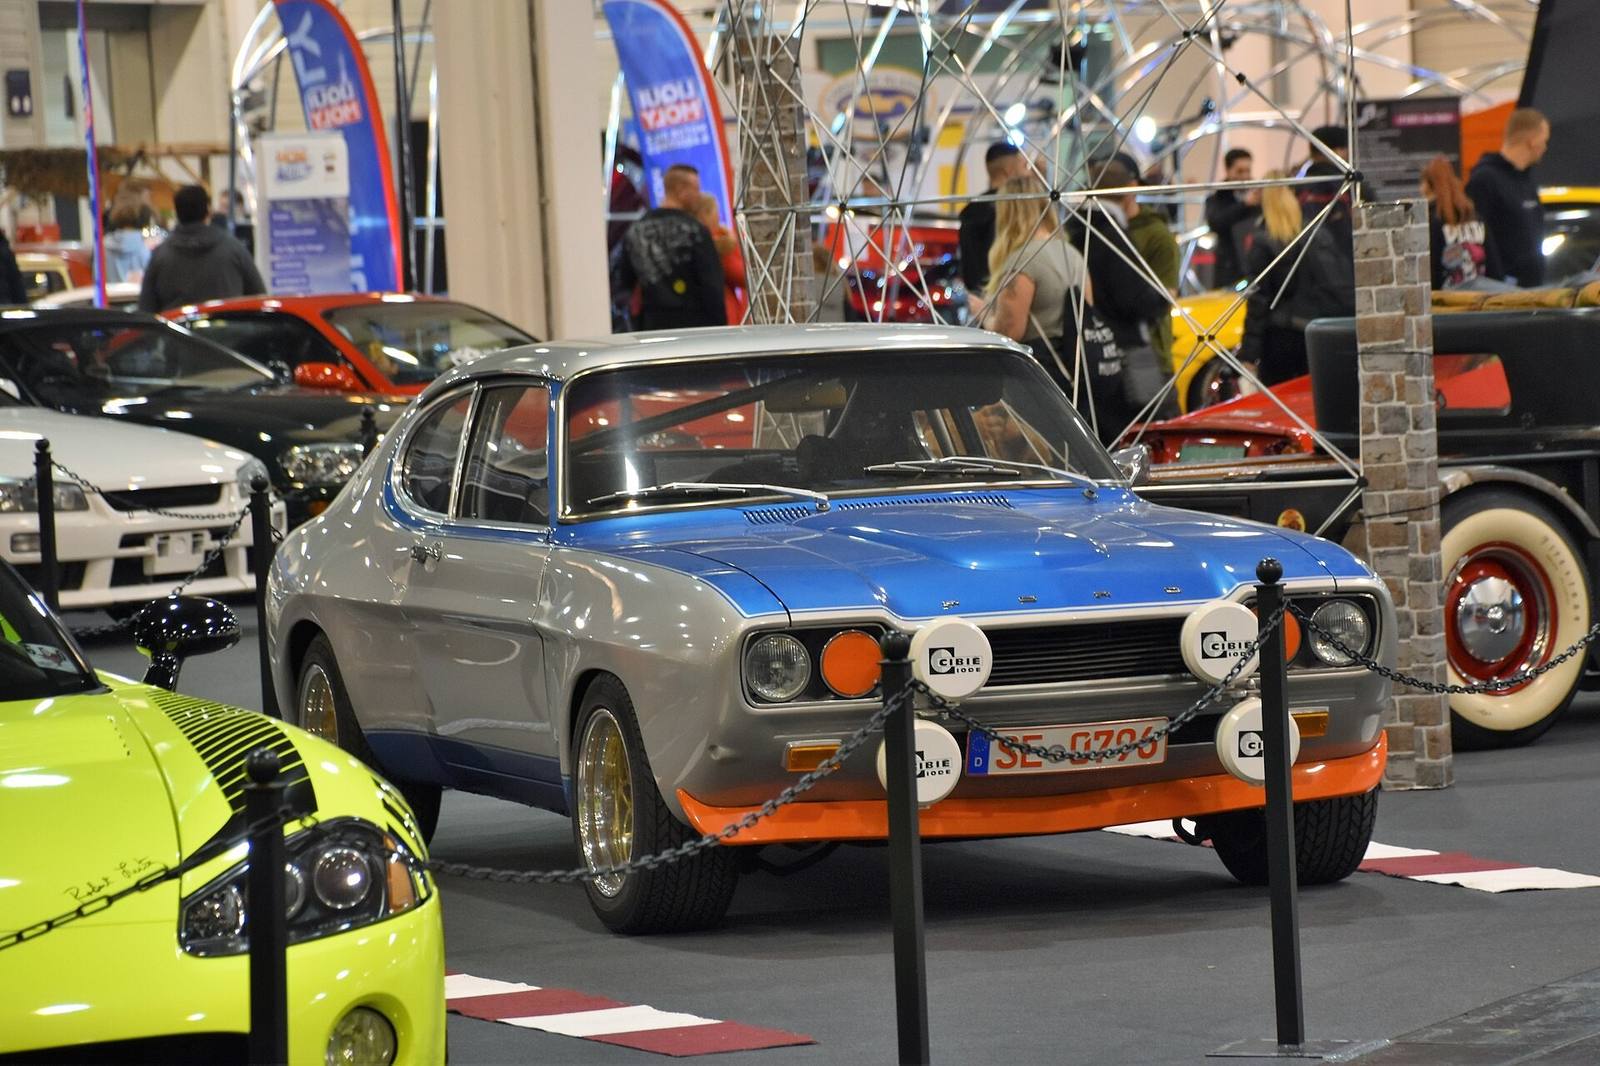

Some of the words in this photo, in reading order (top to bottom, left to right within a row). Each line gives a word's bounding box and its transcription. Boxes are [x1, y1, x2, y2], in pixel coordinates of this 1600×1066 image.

[939, 657, 980, 666] CIBIE
[974, 757, 983, 767] D
[996, 734, 1043, 769] SE
[918, 760, 950, 770] IBIE
